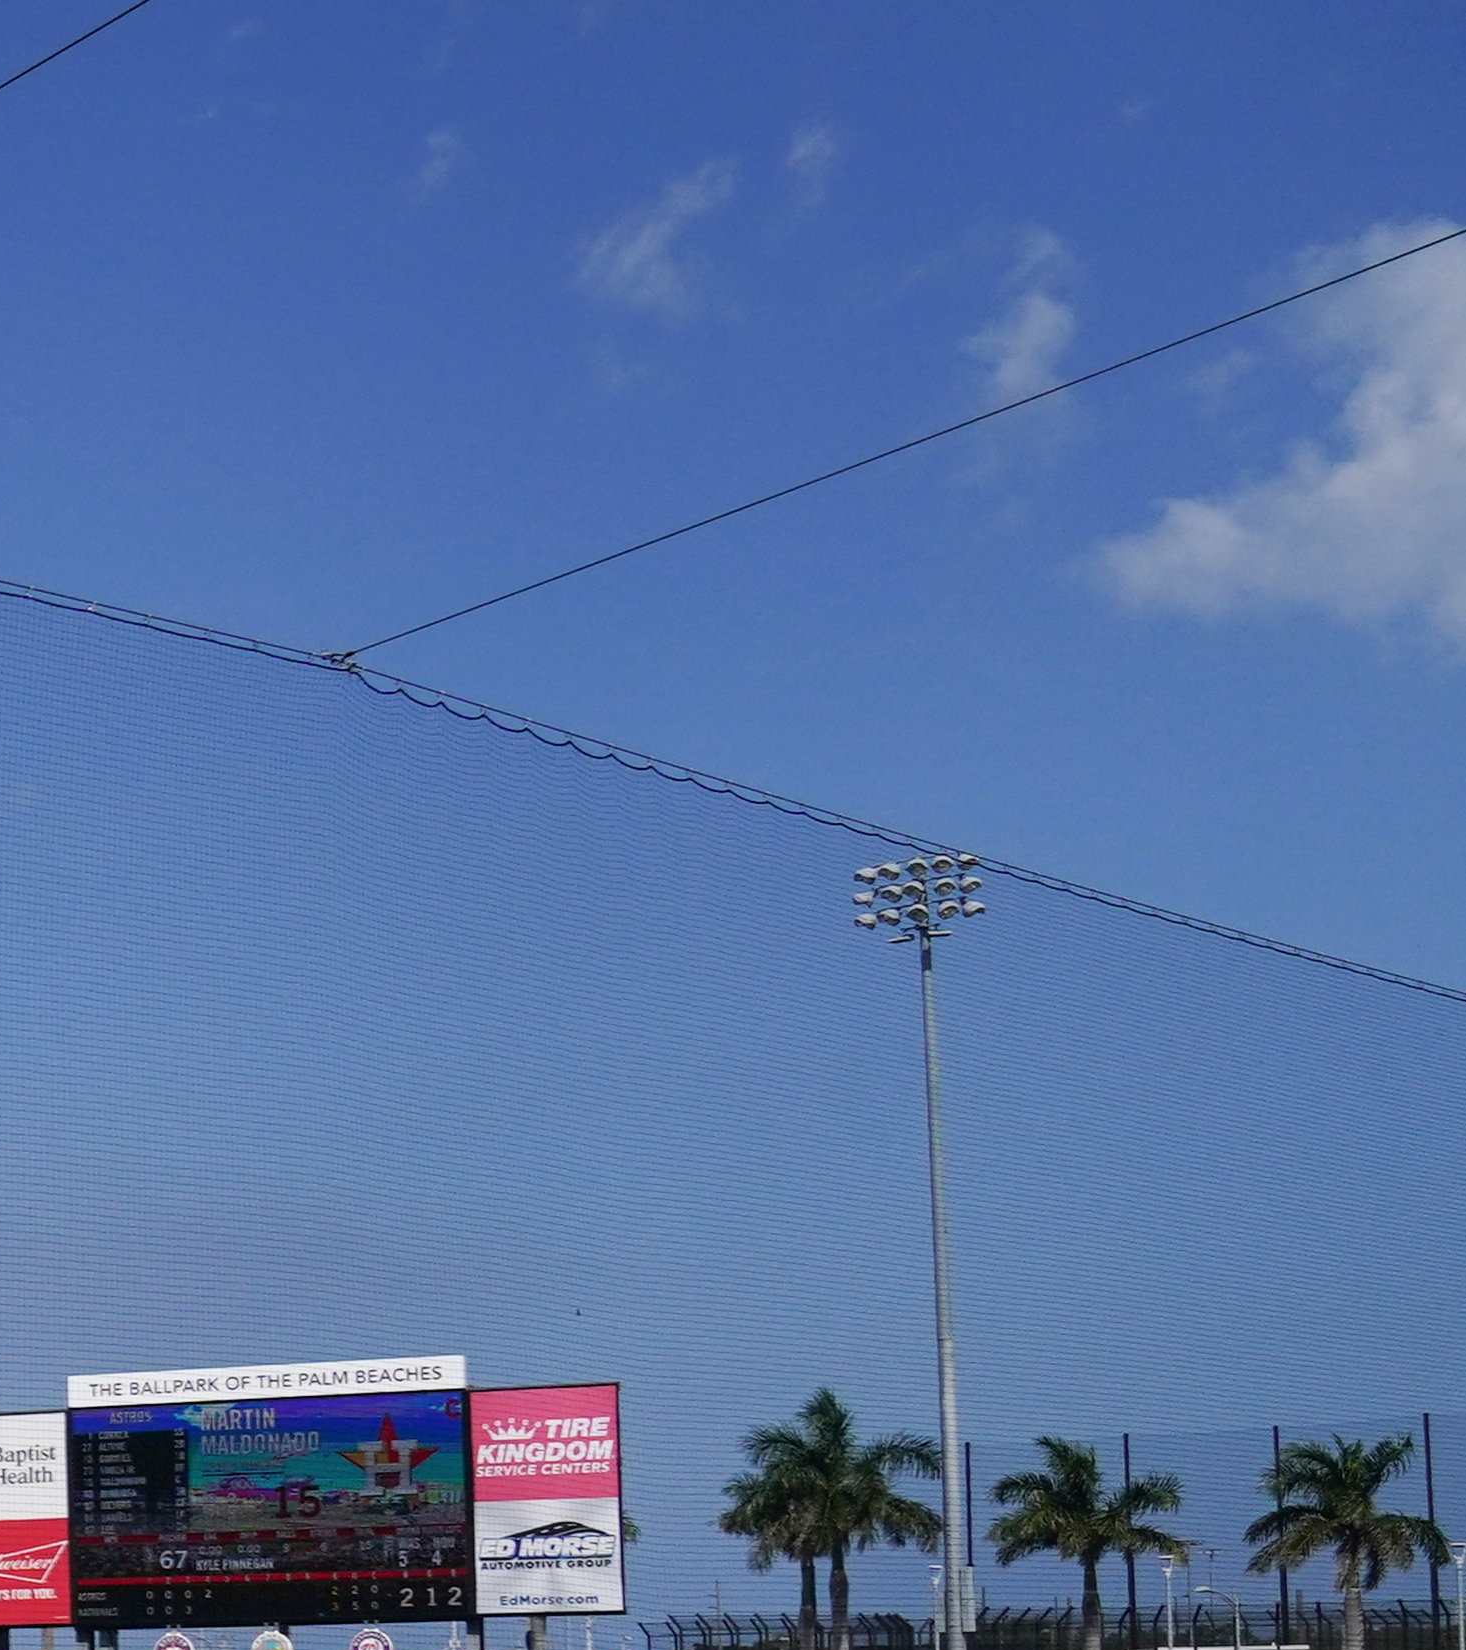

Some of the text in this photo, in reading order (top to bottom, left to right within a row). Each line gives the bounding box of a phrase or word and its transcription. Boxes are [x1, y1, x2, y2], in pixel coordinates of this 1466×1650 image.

[89, 1366, 443, 1397] THE BALLPARK OF THE PALM BEACHES
[201, 1408, 276, 1431] MARTIN
[543, 1416, 610, 1439] TIRE
[201, 1431, 320, 1455] MALDONADO
[477, 1440, 615, 1464] KINGDOM
[475, 1462, 610, 1477] SERVICE CENTERS
[276, 1485, 322, 1518] 15
[479, 1534, 616, 1560] ED MORSE
[159, 1550, 189, 1570] 67
[481, 1559, 612, 1570] AUTOMOTIVE GROUP
[11, 1589, 32, 1600] FOR
[400, 1586, 463, 1607] 2 1 2
[500, 1595, 599, 1606] EdMorse.com
